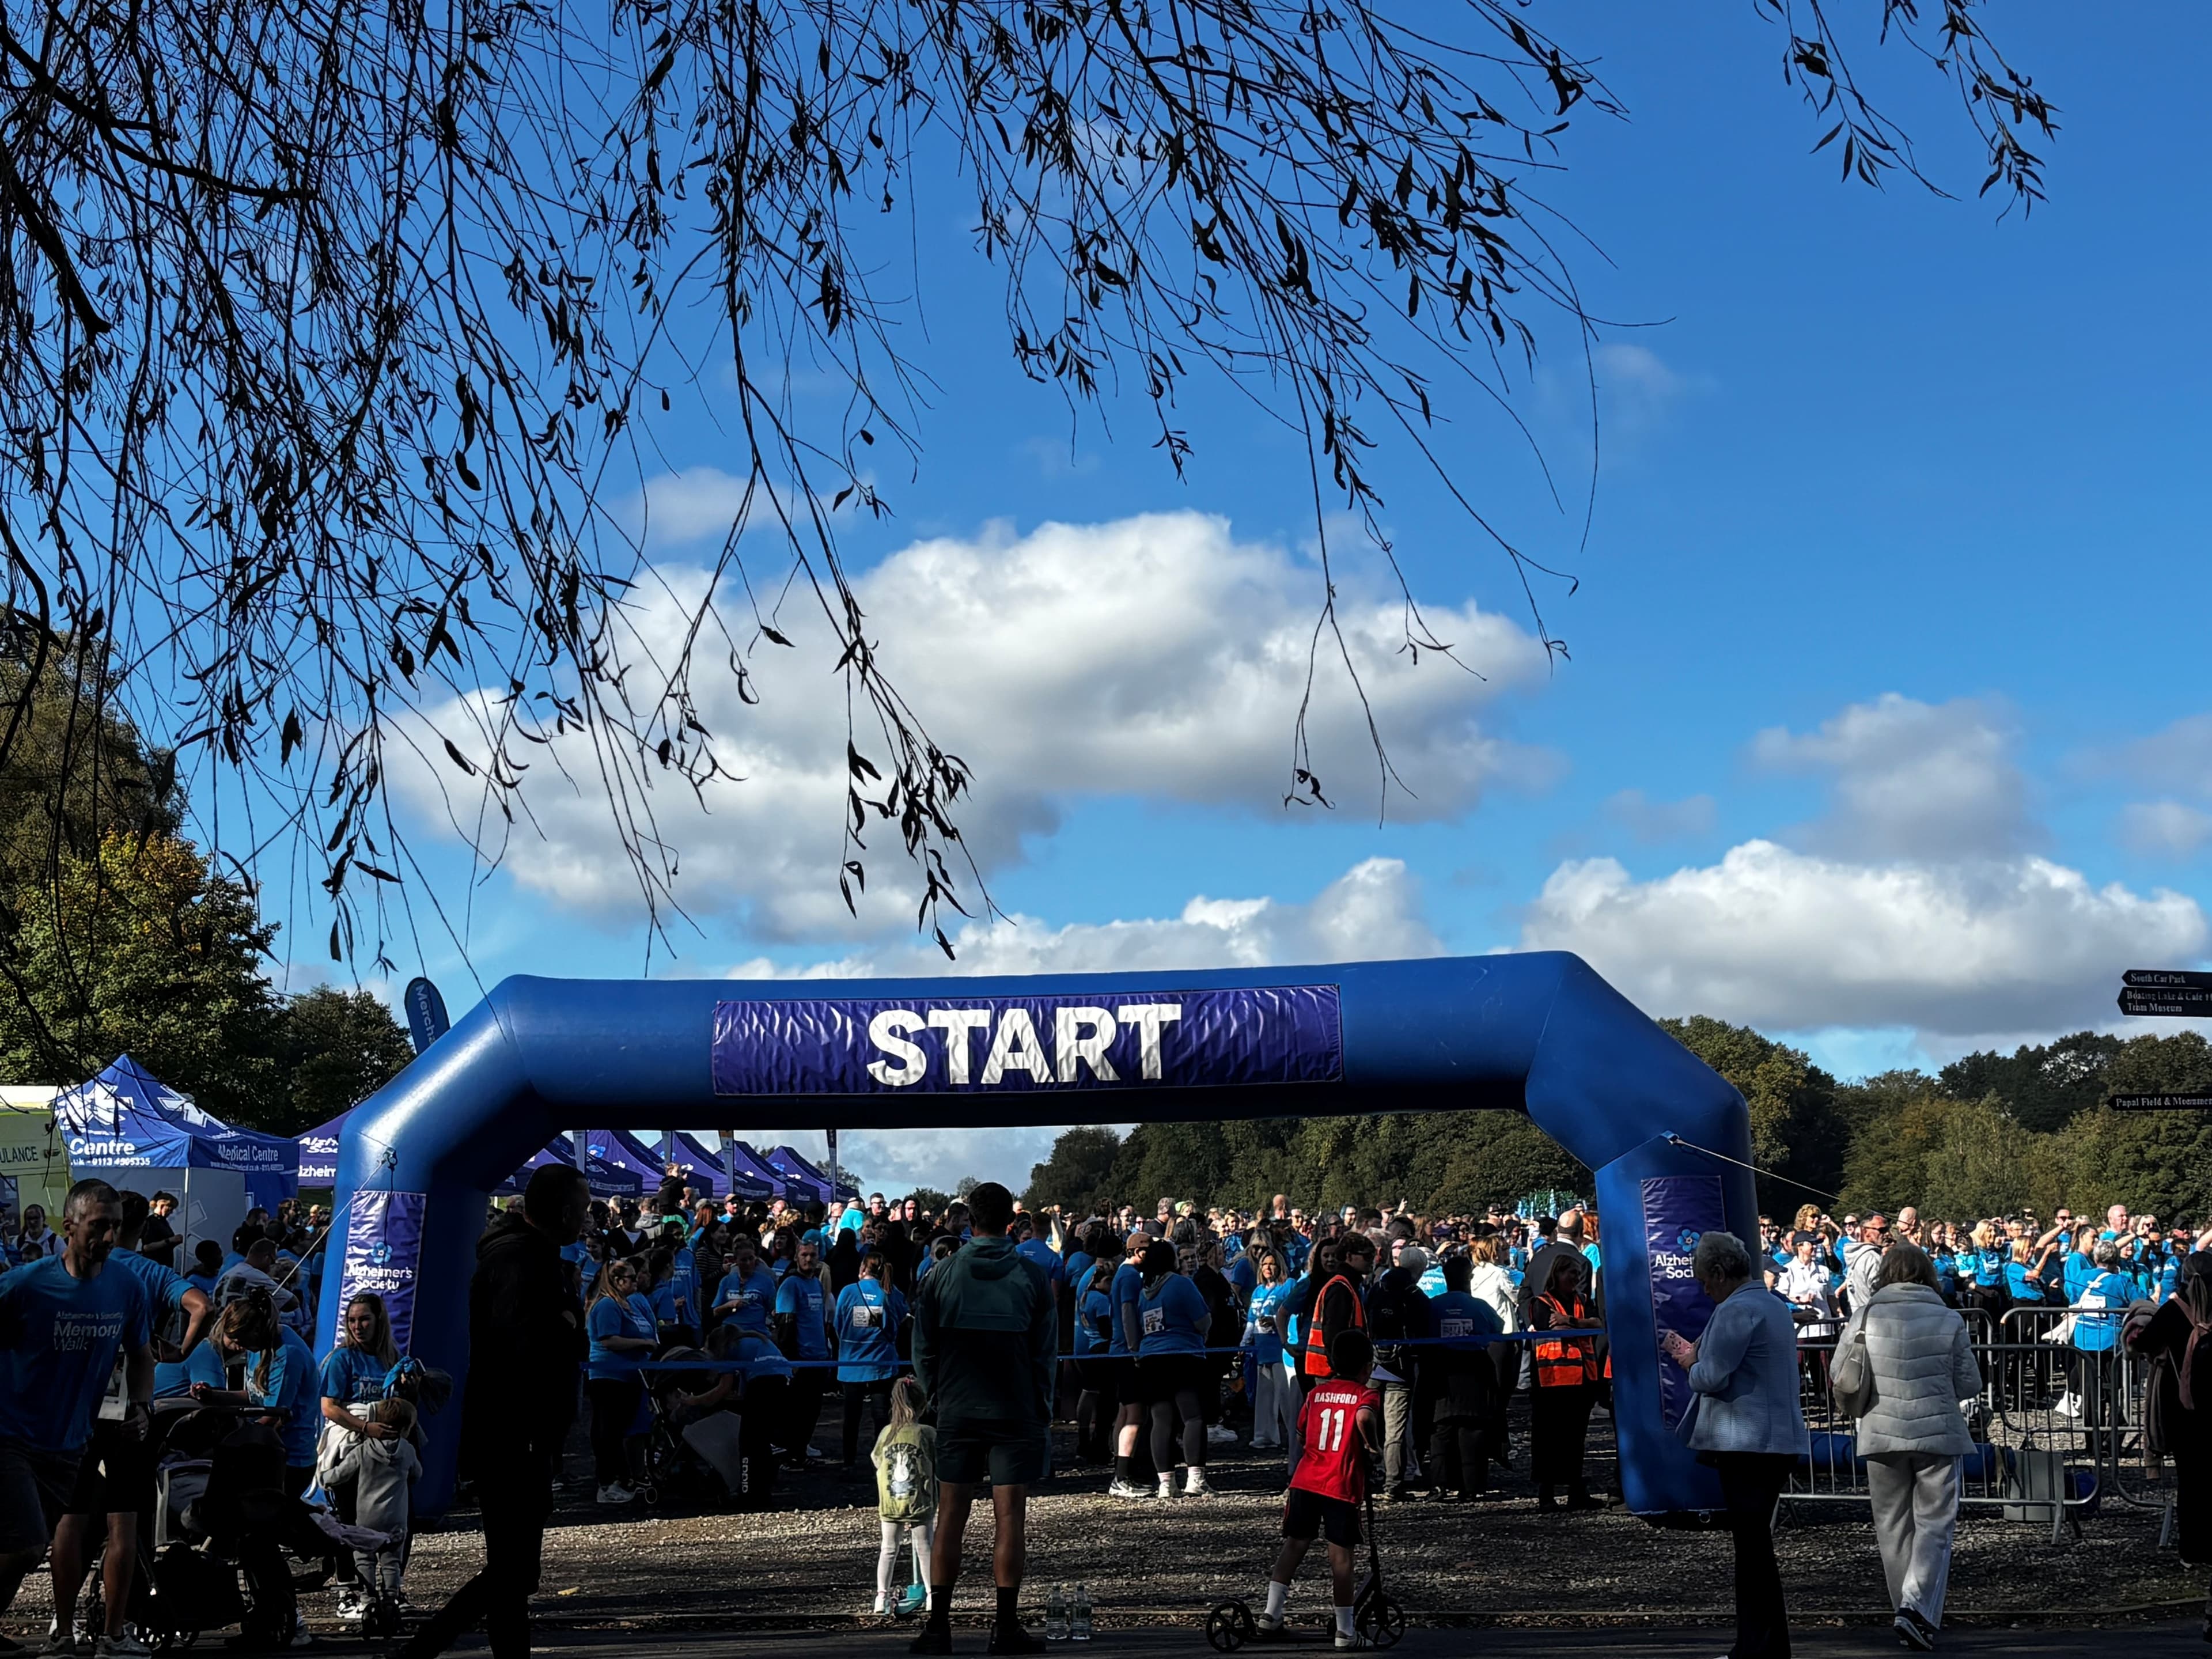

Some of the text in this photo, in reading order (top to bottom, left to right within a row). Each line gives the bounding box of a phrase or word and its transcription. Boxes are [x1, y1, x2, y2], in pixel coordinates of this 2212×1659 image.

[2131, 973, 2186, 983] South Car Park
[2149, 1002, 2182, 1012] Museum
[866, 1002, 1181, 1086] START
[2116, 1097, 2139, 1108] Papal
[2141, 1097, 2161, 1106] Field
[2164, 1097, 2171, 1105] &
[70, 1138, 135, 1156] Centre
[252, 1145, 279, 1162] Centre
[1655, 1253, 1695, 1267] Alzhei
[1666, 1266, 1694, 1279] Soci
[355, 1276, 400, 1293] Society
[54, 1320, 122, 1339] Memory
[1314, 1392, 1358, 1405] RASHFORD
[1318, 1407, 1345, 1452] 11
